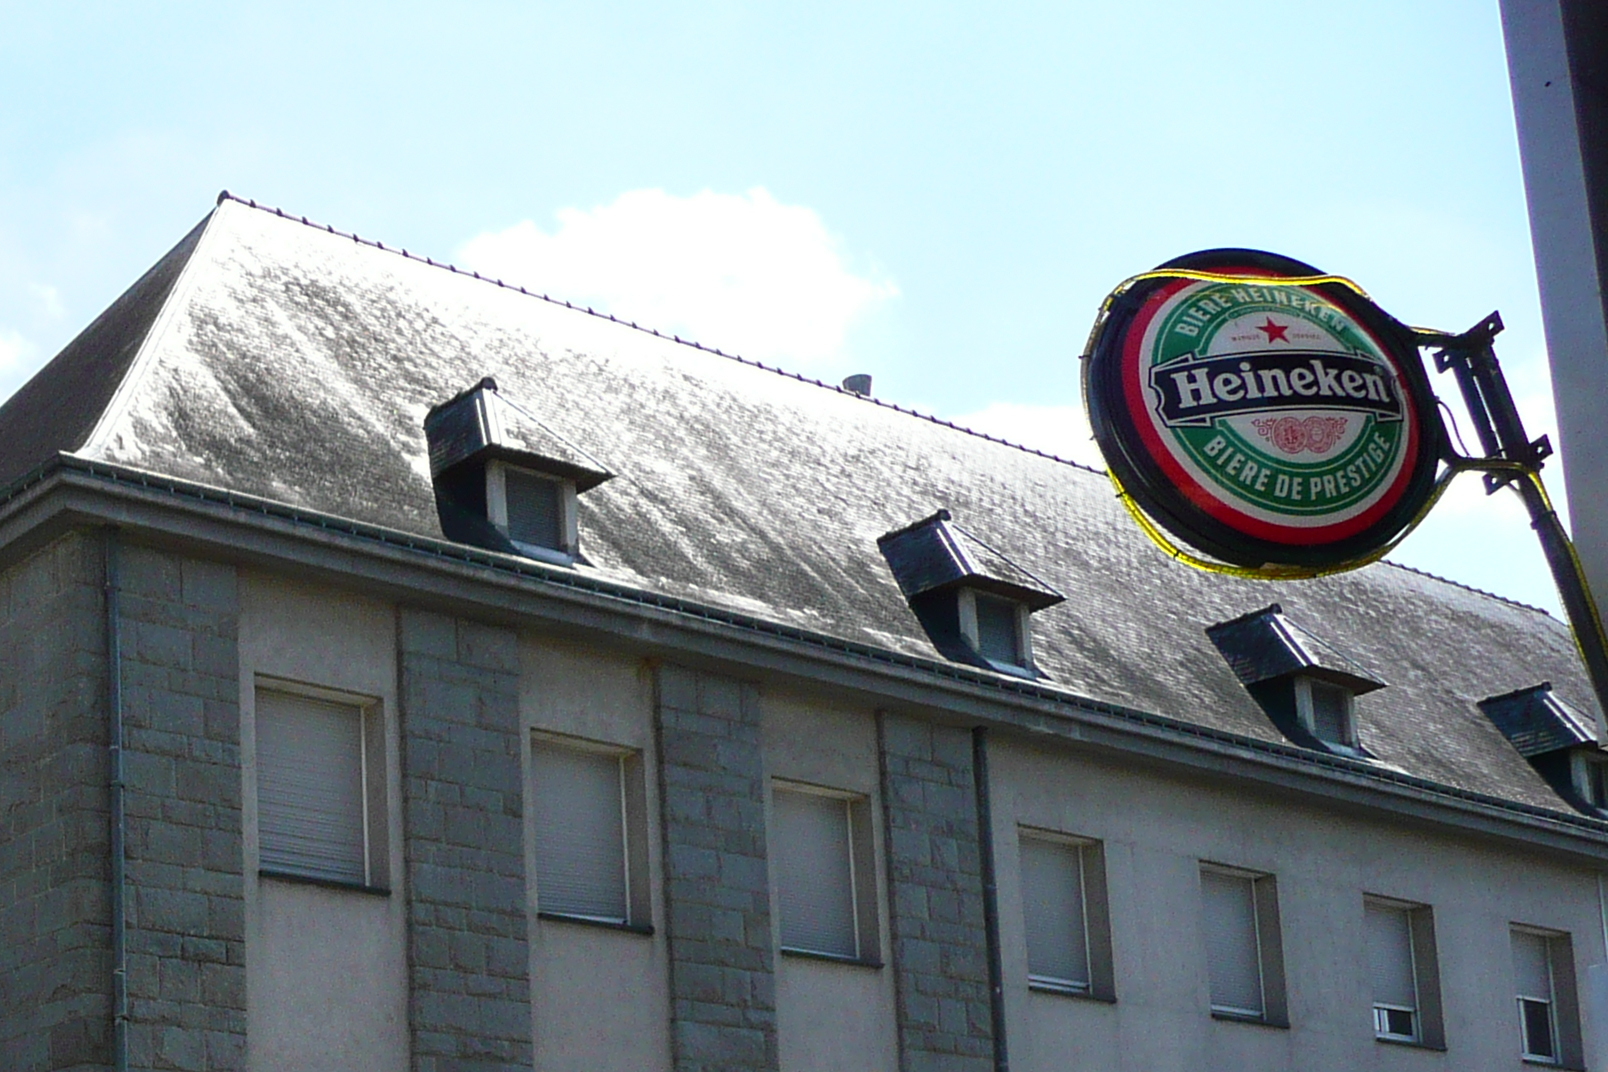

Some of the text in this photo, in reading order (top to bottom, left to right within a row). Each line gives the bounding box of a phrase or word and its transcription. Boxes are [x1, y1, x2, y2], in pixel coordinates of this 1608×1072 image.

[1174, 286, 1348, 338] BIERE HEINEKEN
[1170, 359, 1390, 409] Heineken
[1202, 431, 1391, 501] BIERE DE PRESTIGE
